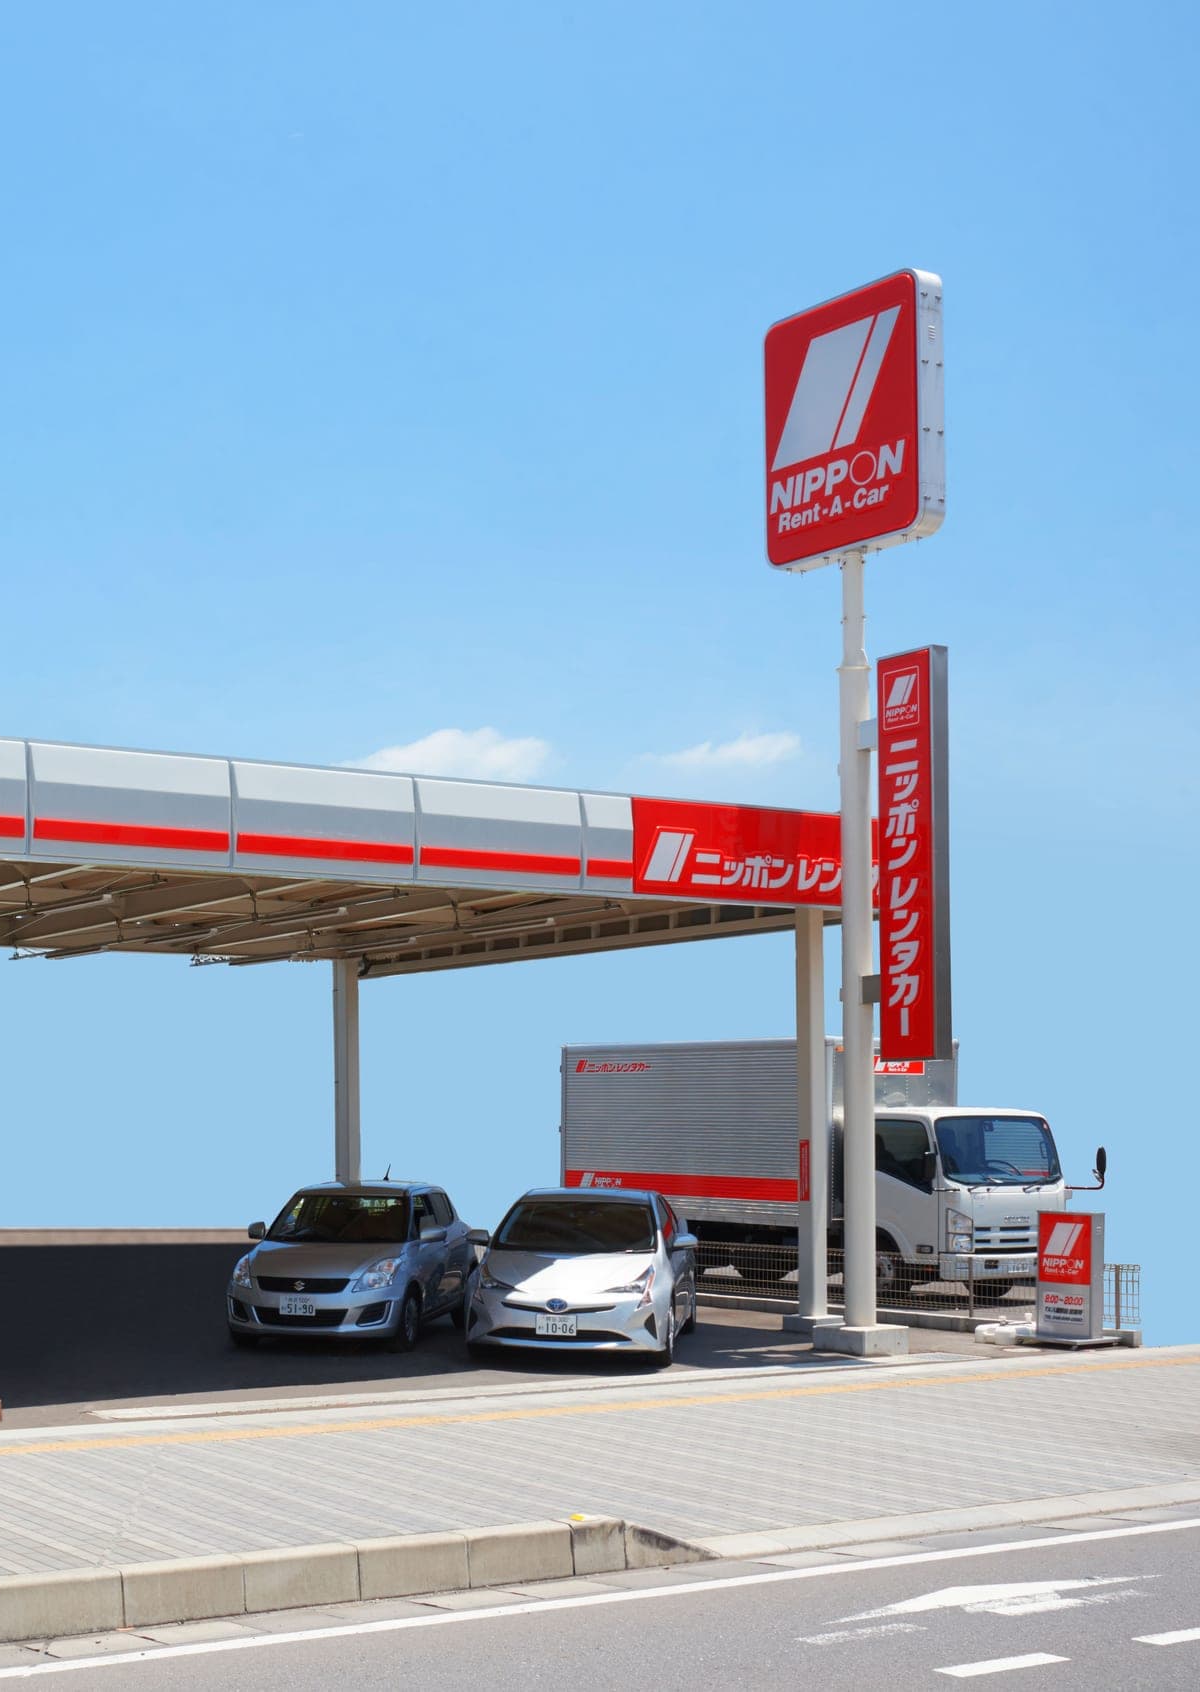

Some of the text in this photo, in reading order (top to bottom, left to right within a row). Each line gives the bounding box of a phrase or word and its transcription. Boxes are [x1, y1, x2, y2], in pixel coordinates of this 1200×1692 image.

[770, 439, 905, 515] NIPPON
[885, 703, 918, 718] NIPPON
[885, 738, 920, 1037] ニッポンレンタカー
[1042, 1257, 1084, 1270] NIPPON
